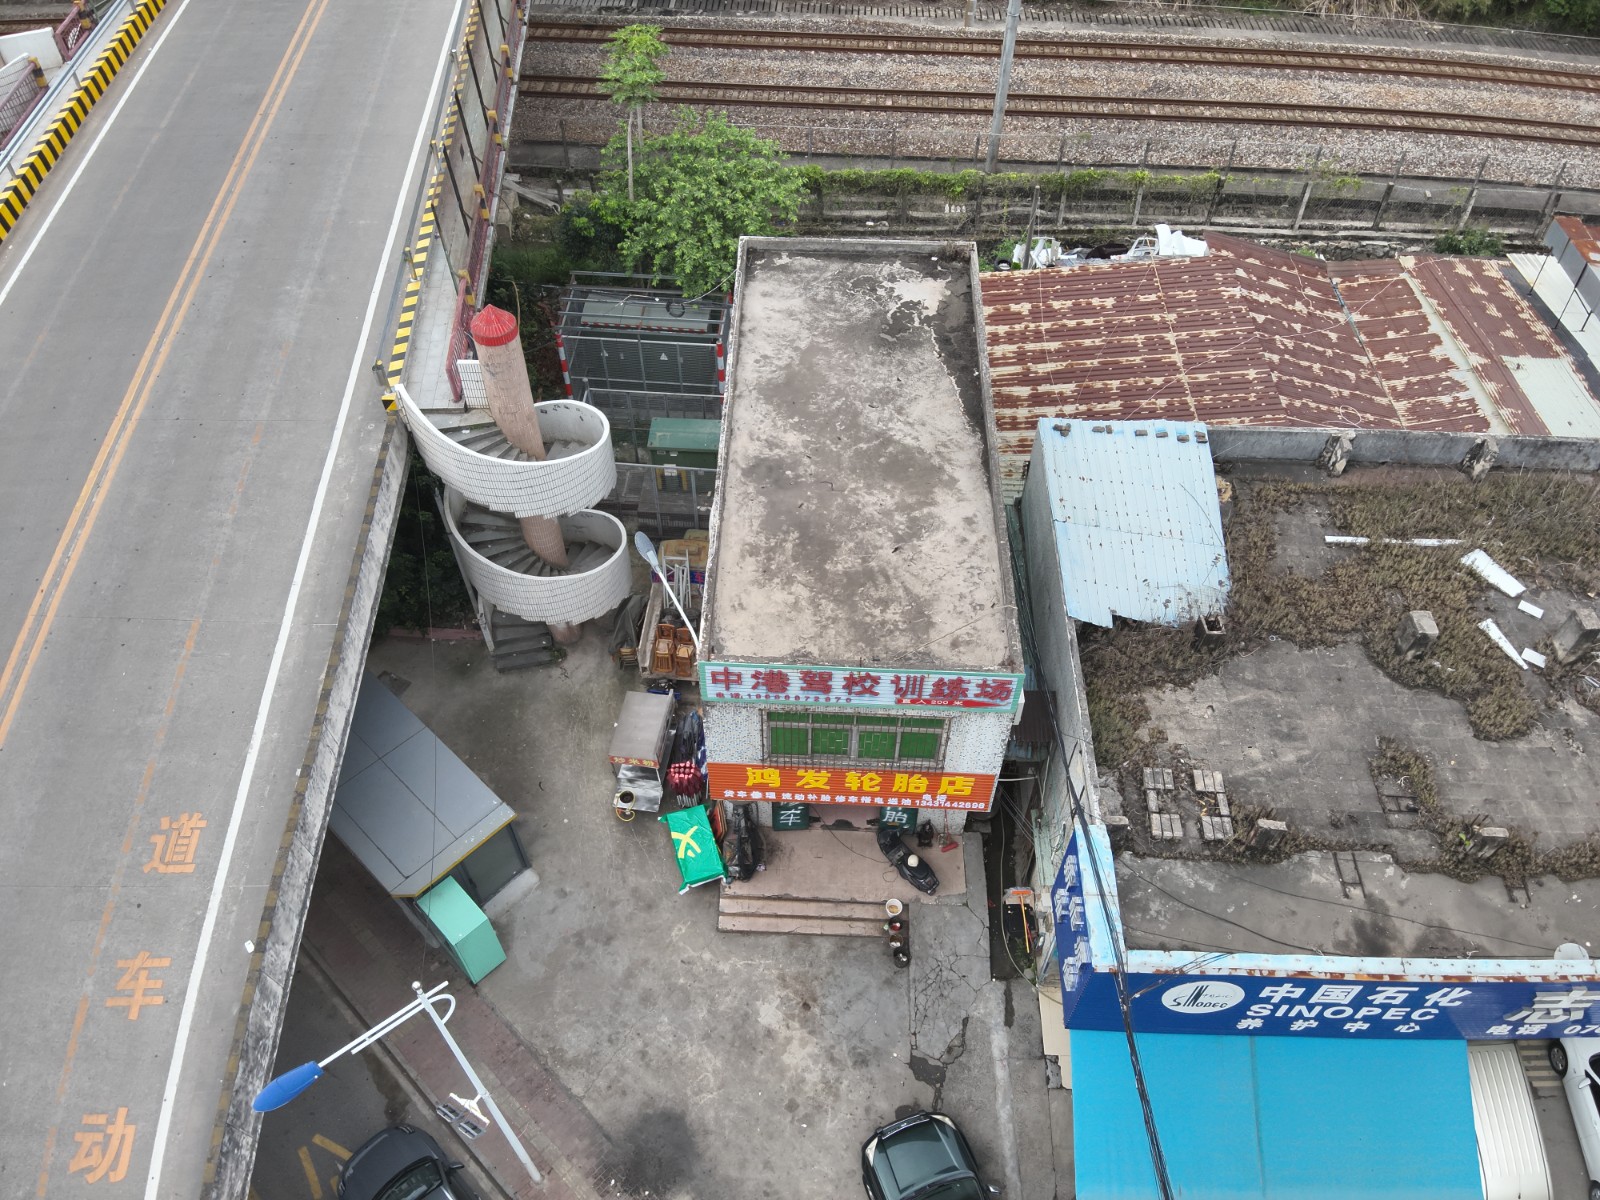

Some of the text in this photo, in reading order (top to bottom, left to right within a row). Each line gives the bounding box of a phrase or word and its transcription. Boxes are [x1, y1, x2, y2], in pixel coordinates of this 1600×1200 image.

[711, 666, 1013, 701] 中港驾校训练场
[746, 767, 976, 796] 鸿发轮胎店
[1258, 983, 1472, 1007] 中国石化
[1246, 1004, 1440, 1021] SINOPEC
[1236, 1018, 1421, 1033] 养护中心
[1485, 1024, 1548, 1035] 电话
